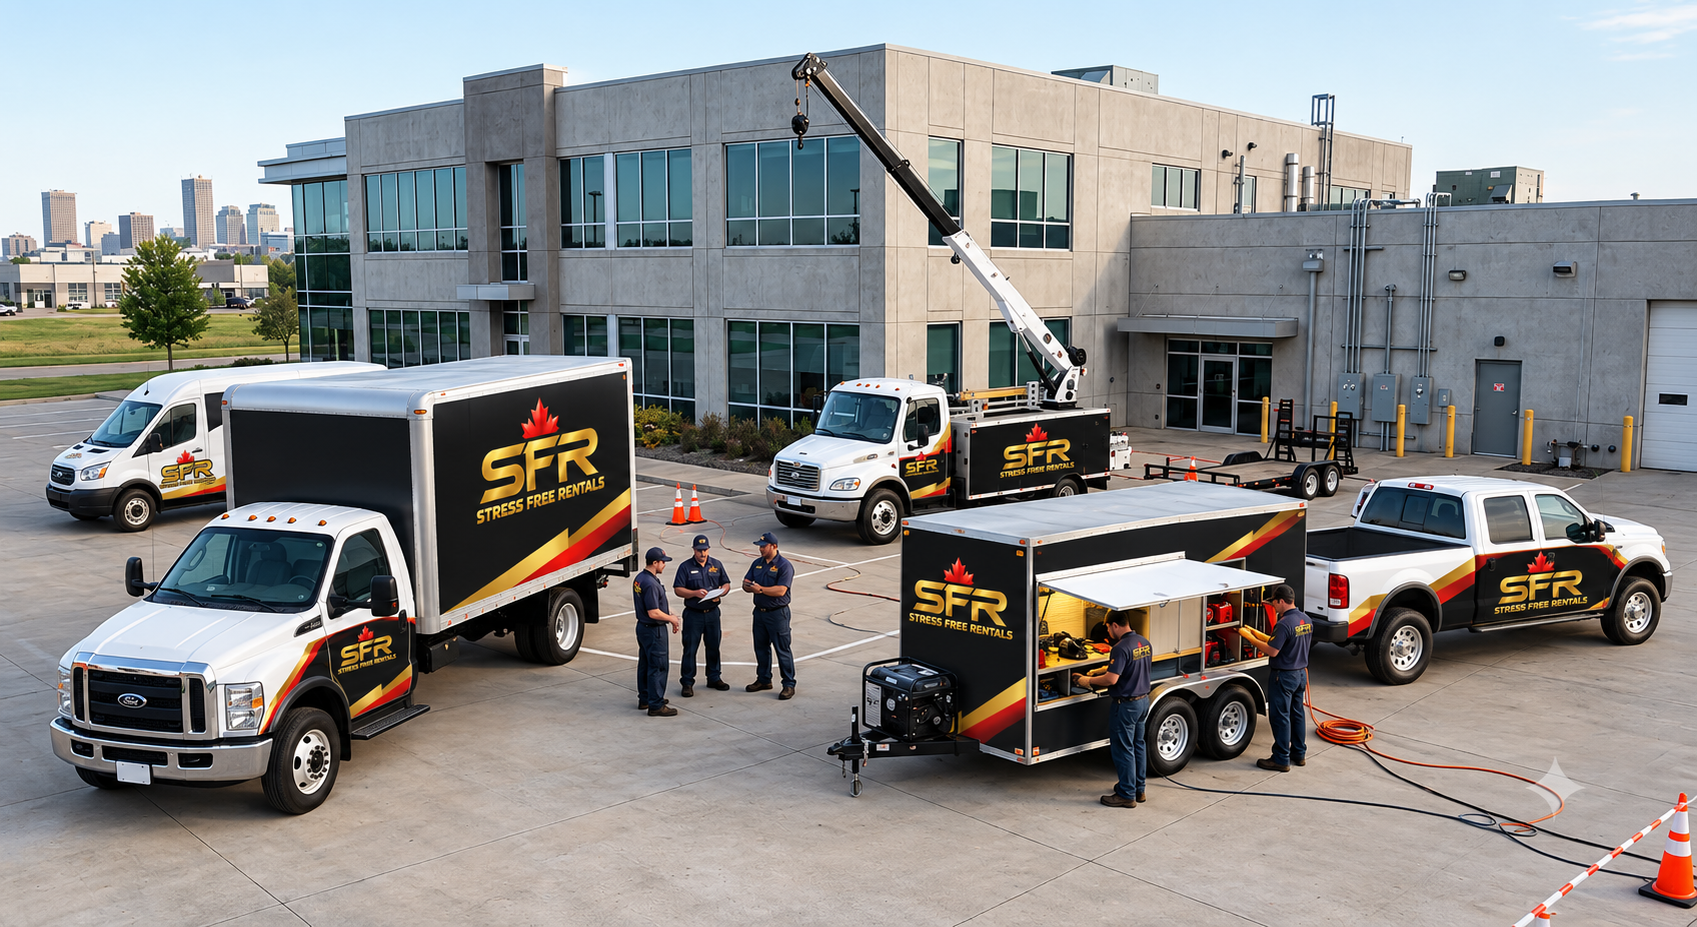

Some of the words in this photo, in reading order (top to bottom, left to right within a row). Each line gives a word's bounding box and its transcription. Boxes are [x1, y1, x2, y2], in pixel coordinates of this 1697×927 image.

[480, 427, 599, 504] SFR
[905, 459, 938, 474] SFR
[1002, 438, 1071, 470] SFR
[476, 498, 524, 525] STRESS
[526, 489, 555, 510] FREE
[557, 476, 605, 501] RENTALS
[1498, 569, 1583, 604] SFR
[913, 579, 1008, 627] SFR
[1494, 604, 1526, 615] STRESS
[1527, 600, 1550, 610] FREE
[1551, 596, 1588, 608] RENTALS
[909, 612, 942, 627] STRESS
[944, 619, 968, 632] FREE
[970, 623, 1013, 640] RENTALS
[340, 635, 393, 667] SFR
